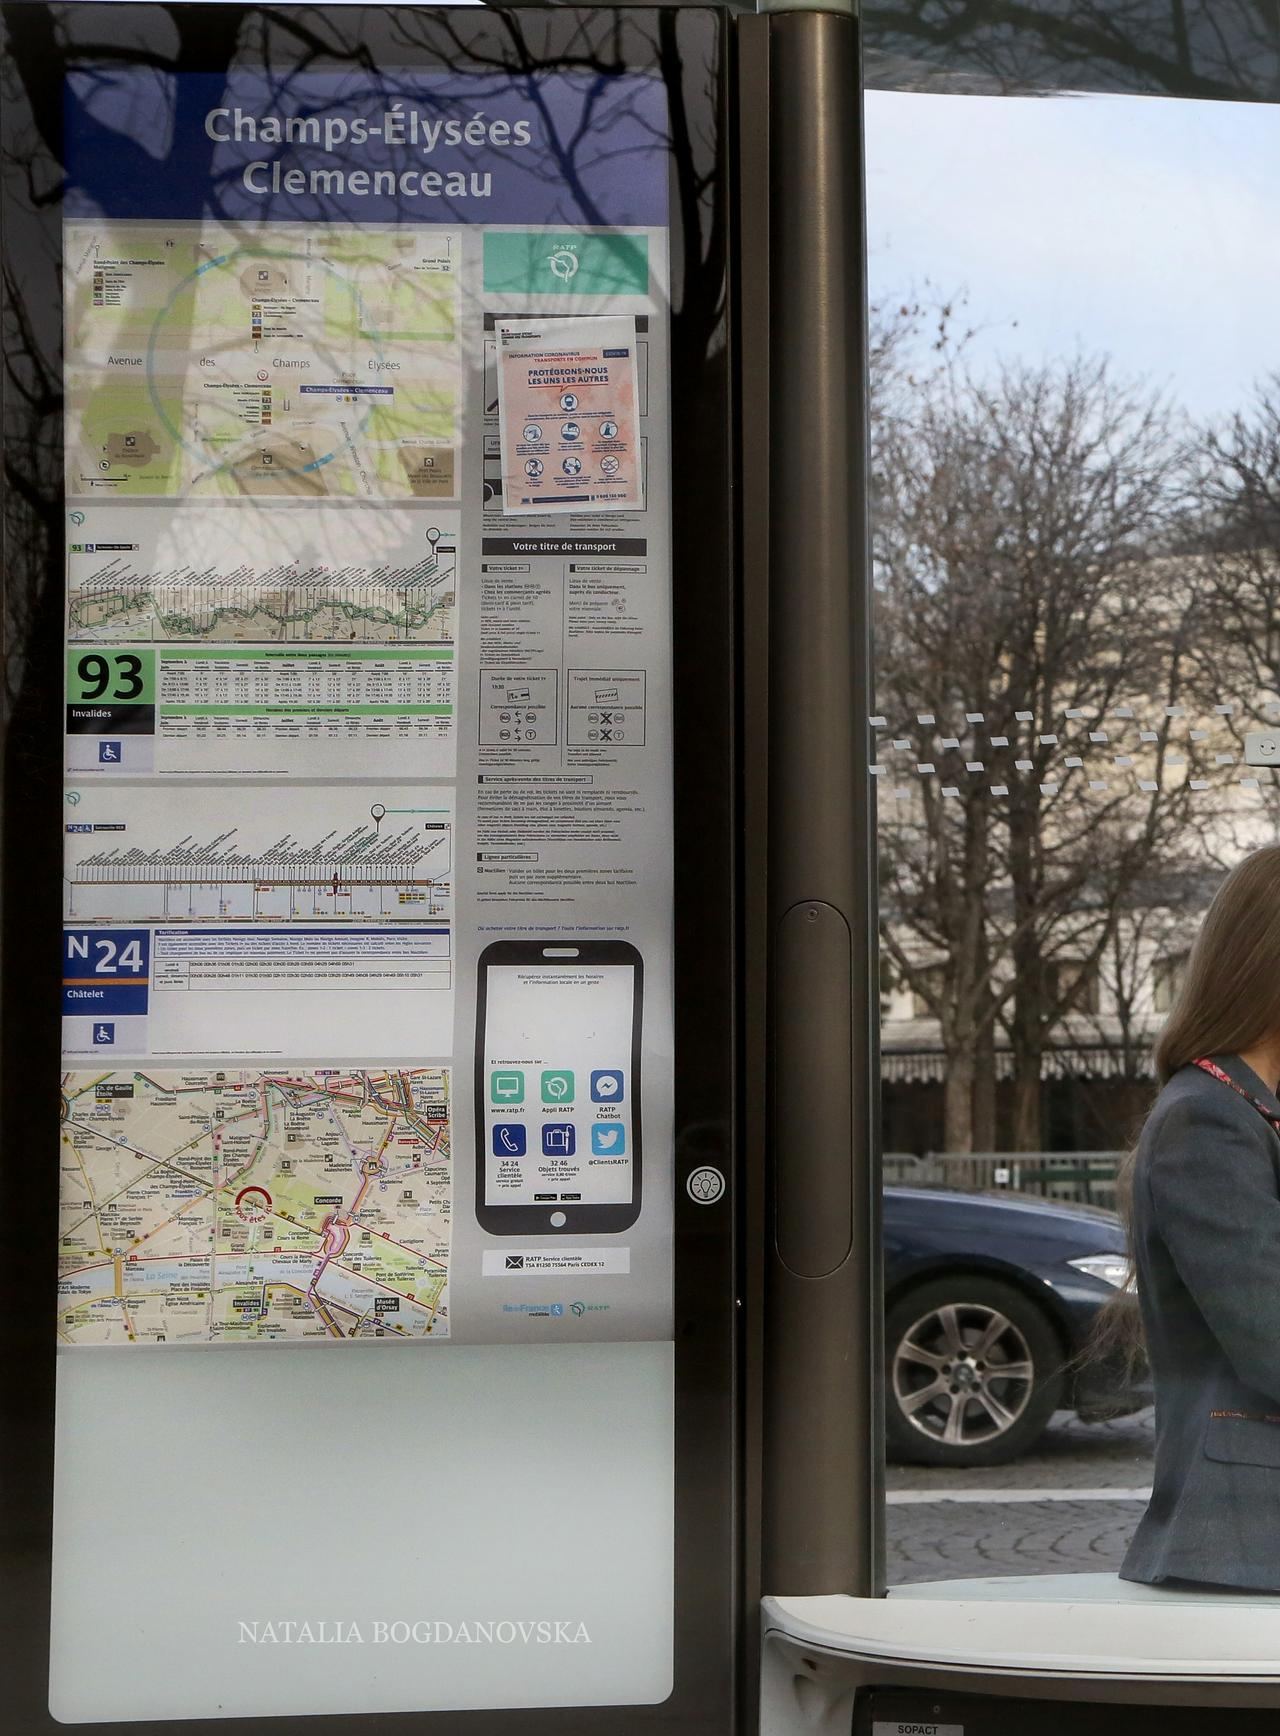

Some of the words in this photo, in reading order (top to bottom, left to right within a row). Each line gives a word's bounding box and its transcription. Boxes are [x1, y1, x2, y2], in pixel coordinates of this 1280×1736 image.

[204, 103, 532, 154] Champs-Élysées
[243, 161, 492, 197] Clemenceau
[107, 356, 143, 366] Avenue
[200, 358, 216, 367] des
[272, 358, 311, 369] Champs
[528, 367, 608, 377] PROTÉGEONS-NOUS
[528, 377, 542, 385] LES
[577, 375, 609, 383] AUTRES
[306, 386, 349, 394] Champs-Élysées
[72, 544, 82, 552] 93
[513, 542, 537, 550] Votre
[540, 542, 559, 551] titre
[561, 542, 573, 550] de
[575, 543, 616, 552] transport
[77, 654, 144, 700] 93
[72, 709, 112, 718] Invalides
[67, 936, 89, 959] N
[95, 940, 143, 973] 24
[67, 990, 104, 998] Châtelet
[249, 1215, 266, 1223] êtes
[157, 1272, 178, 1280] Seine
[897, 1725, 938, 1735] SOPACT
